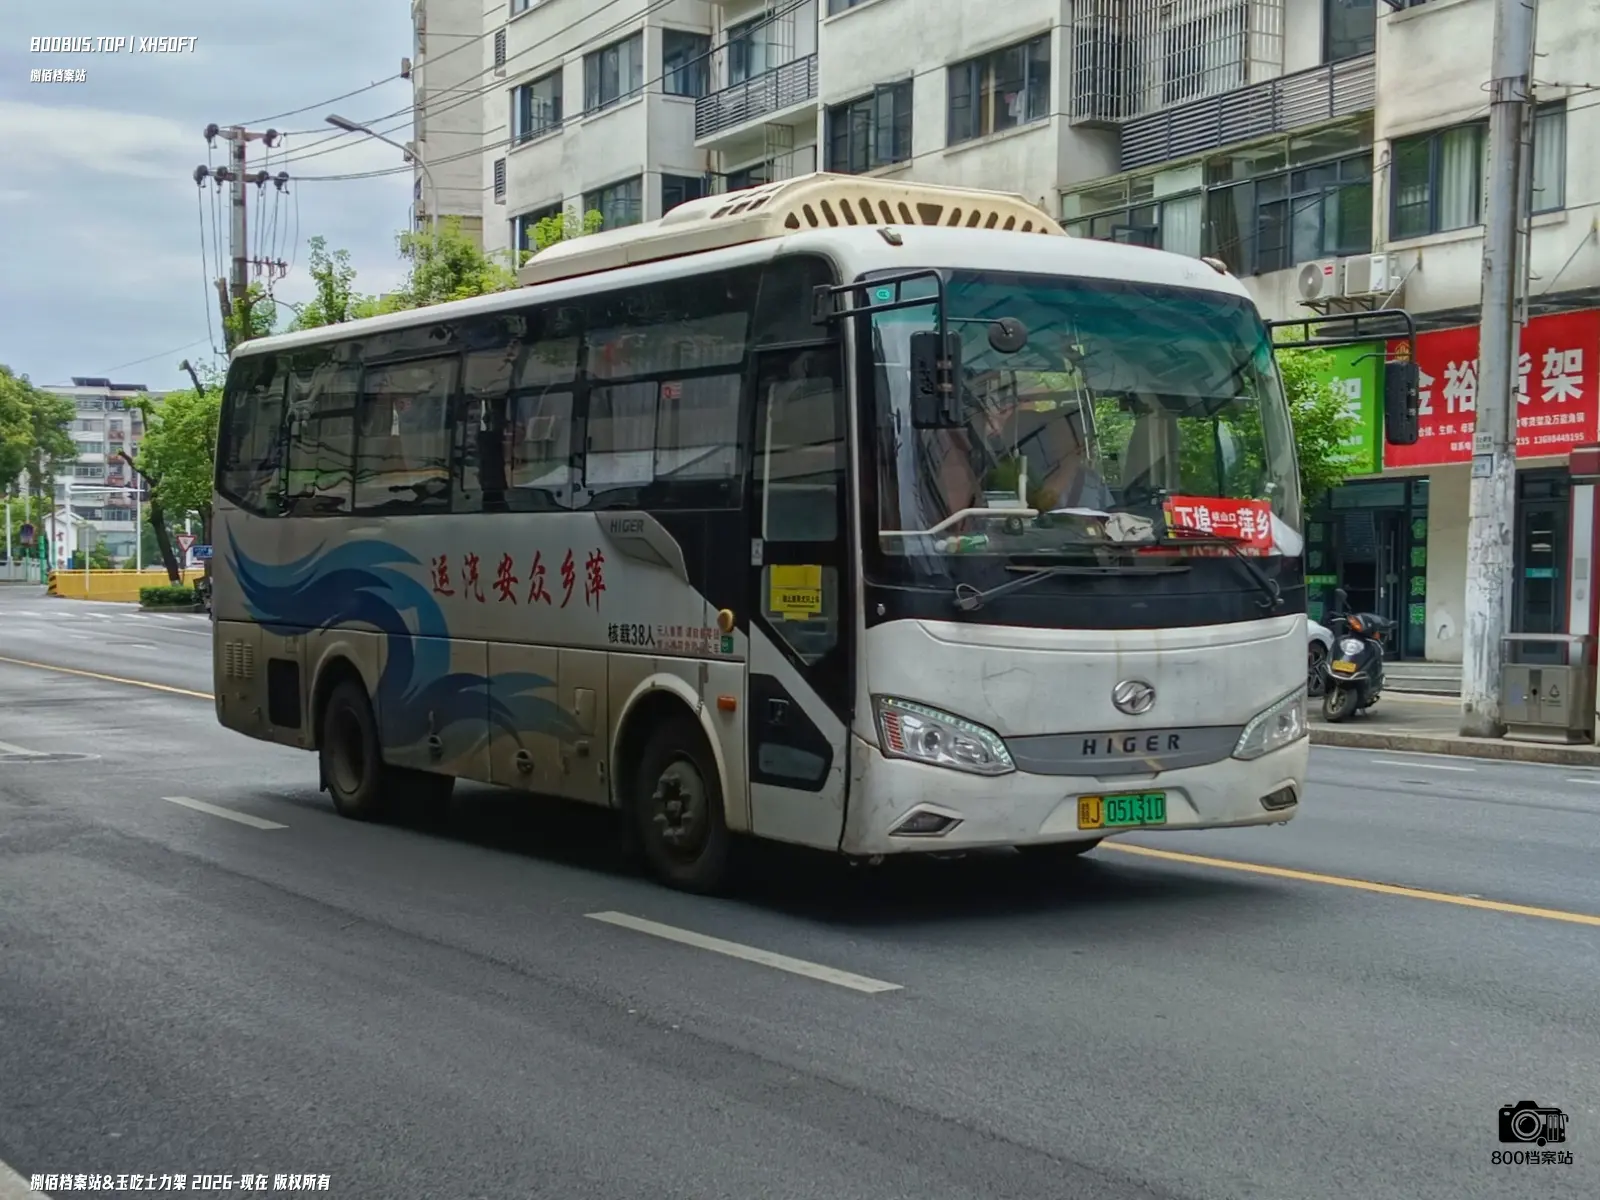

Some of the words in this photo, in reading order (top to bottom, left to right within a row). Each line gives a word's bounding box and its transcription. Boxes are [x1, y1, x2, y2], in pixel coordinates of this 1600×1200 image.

[610, 518, 645, 533] HIGER
[1175, 505, 1213, 532] 下埠
[1237, 508, 1269, 540] 萍乡
[607, 622, 656, 646] 核载38人
[1082, 734, 1181, 756] HIGER
